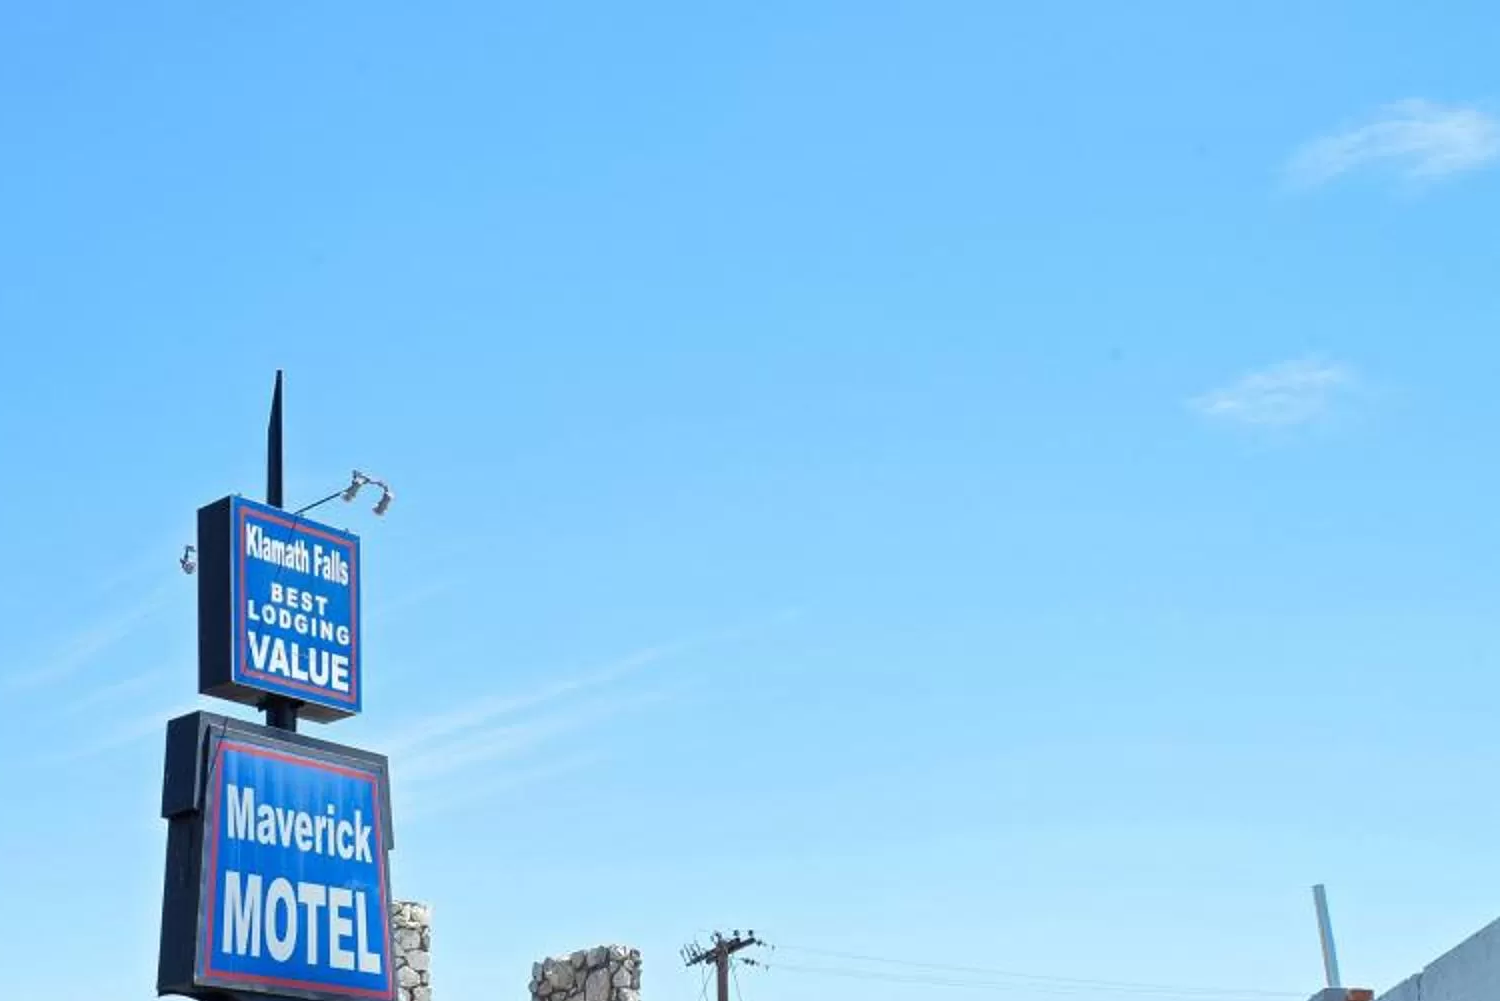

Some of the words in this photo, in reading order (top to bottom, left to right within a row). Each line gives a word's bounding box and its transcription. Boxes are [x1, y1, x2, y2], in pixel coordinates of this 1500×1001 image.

[246, 523, 309, 575] Klamath
[314, 543, 349, 586] Falls
[248, 599, 350, 646] LODGING
[271, 582, 328, 616] BEST
[247, 630, 349, 692] VALUE
[227, 783, 373, 864] Maverick
[222, 869, 381, 975] MOTEL
